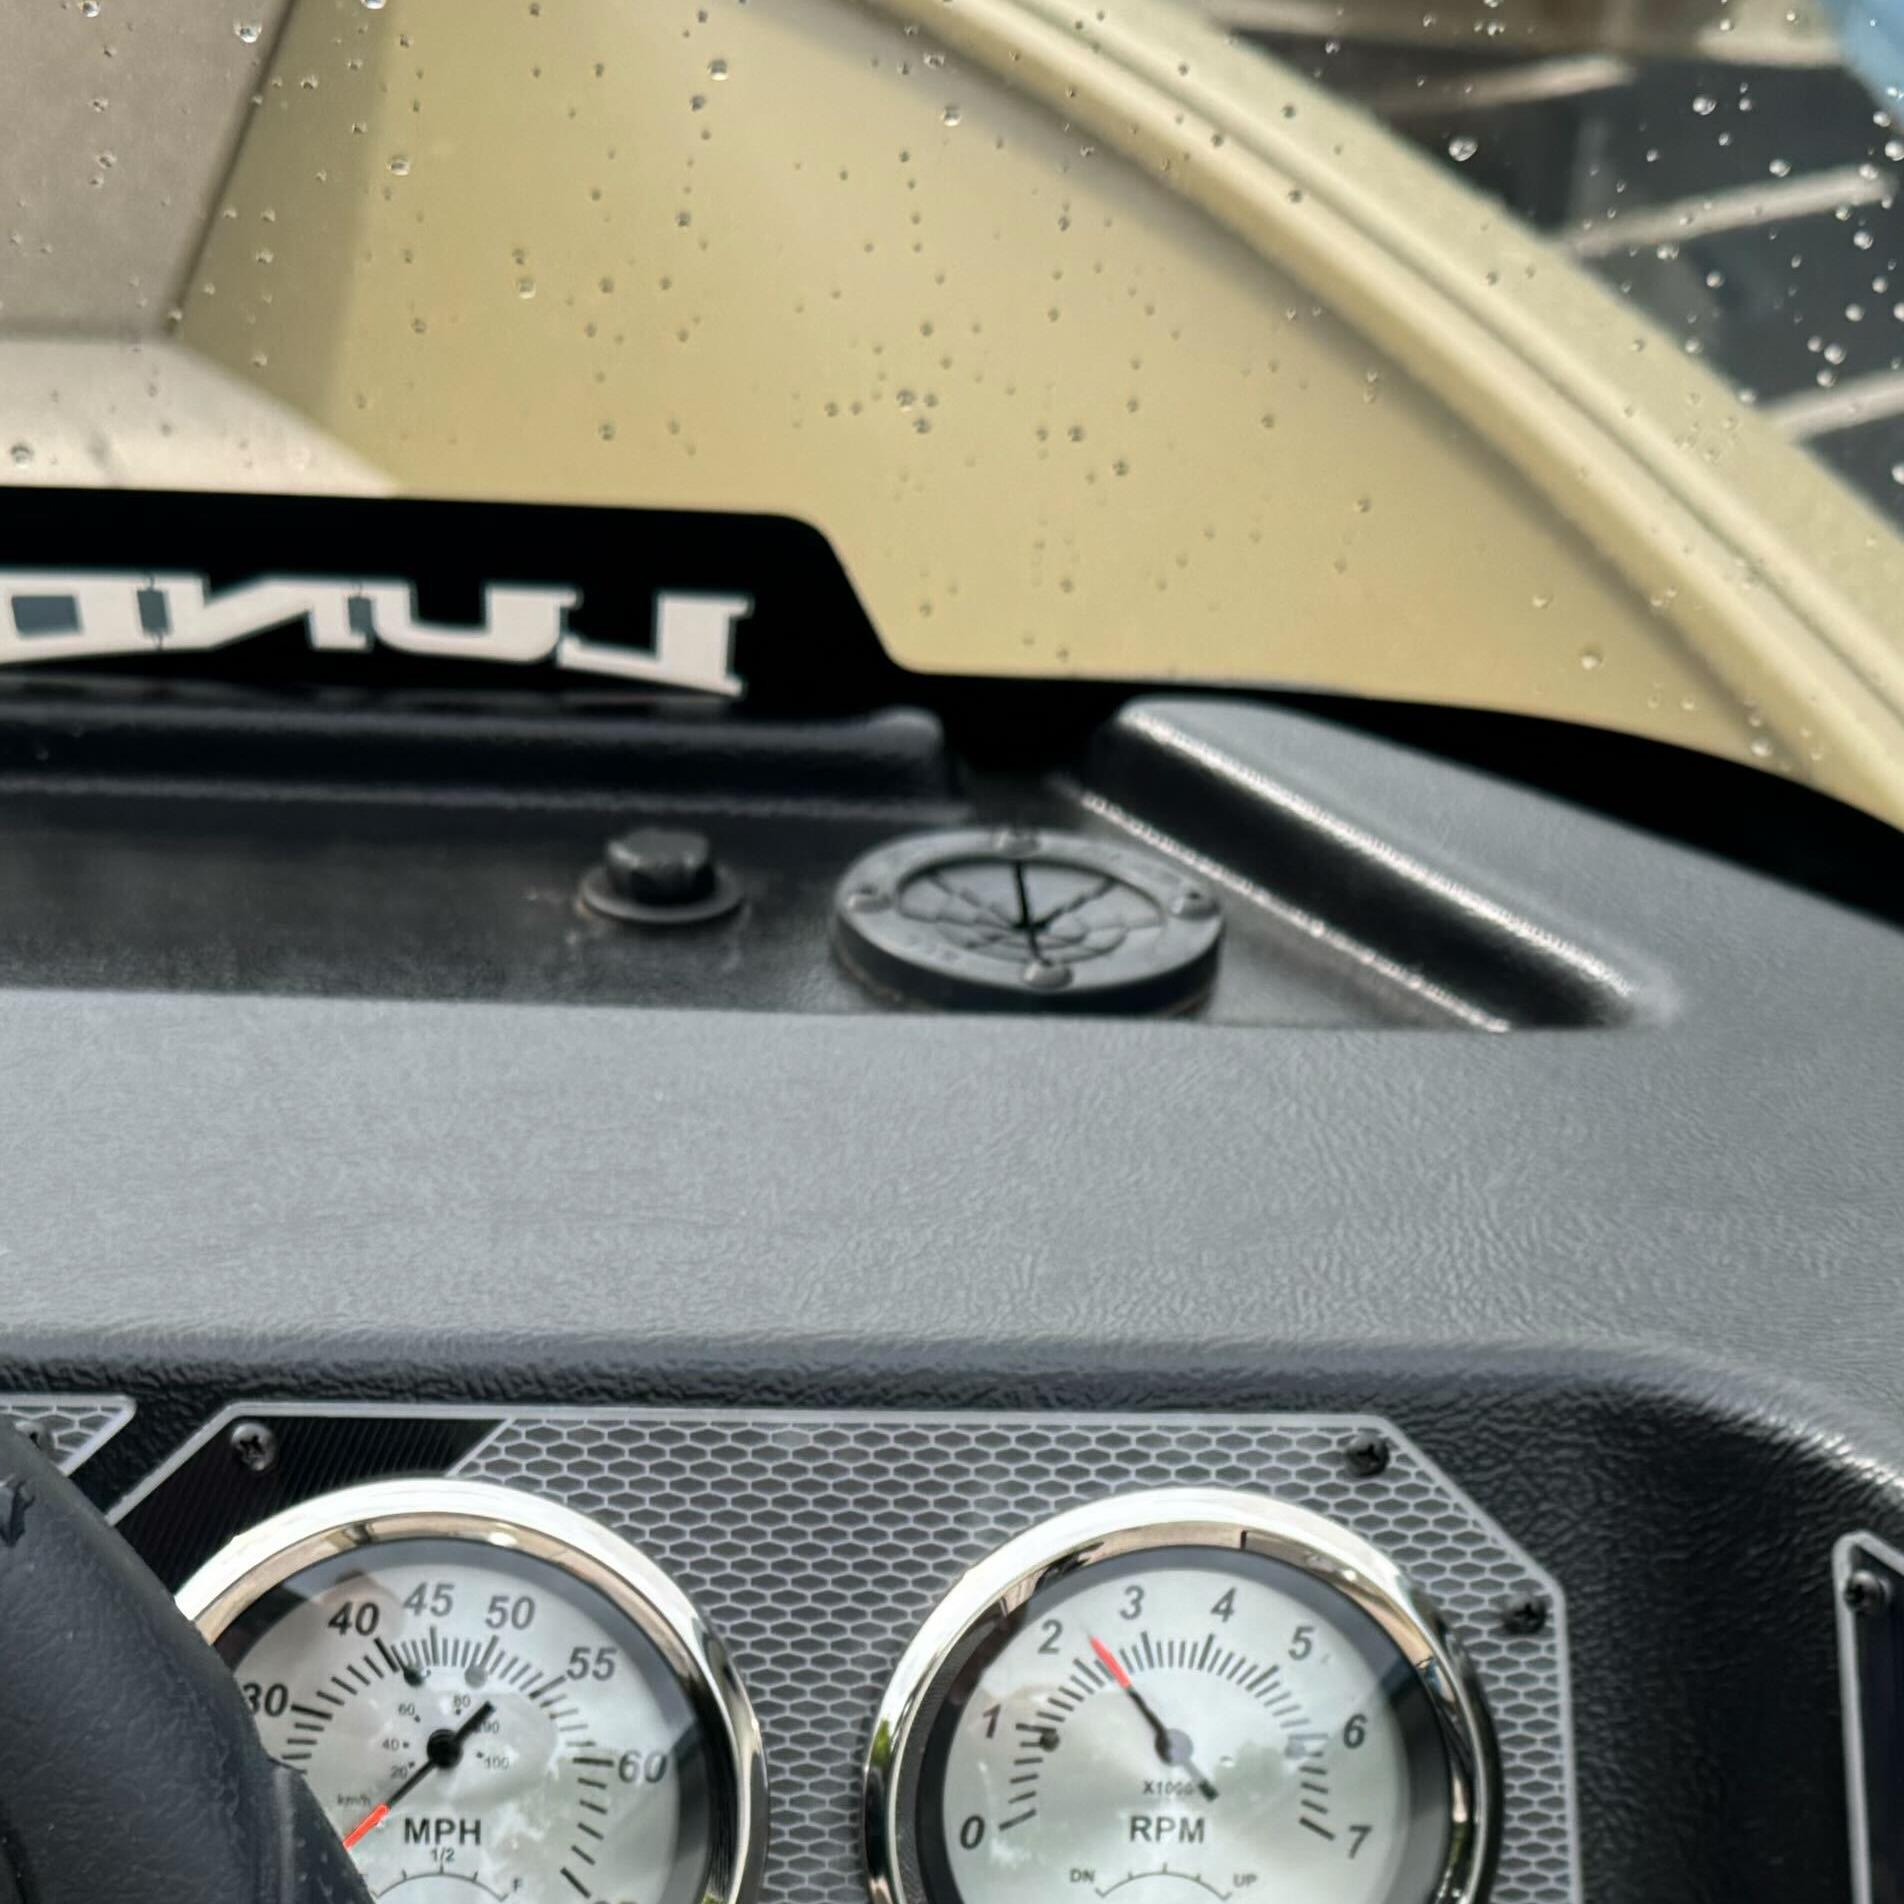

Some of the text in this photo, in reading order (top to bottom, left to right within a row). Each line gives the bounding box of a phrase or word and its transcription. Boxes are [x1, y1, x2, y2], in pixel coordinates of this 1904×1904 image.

[402, 1581, 455, 1618] 45
[485, 1595, 536, 1631] 50
[1120, 1585, 1146, 1620] 3
[1210, 1587, 1237, 1622] 4
[327, 1602, 380, 1637] 40
[1038, 1618, 1065, 1655] 2
[1288, 1625, 1314, 1661] 5
[565, 1646, 617, 1682] 55
[398, 1703, 416, 1718] 60
[982, 1704, 1002, 1739] 1
[382, 1738, 400, 1752] 40
[1342, 1714, 1366, 1749] 6
[390, 1765, 409, 1780] 20
[485, 1754, 510, 1771] 100
[617, 1752, 667, 1785] 60
[404, 1817, 482, 1846] MPH
[959, 1815, 985, 1850] 0
[1129, 1815, 1206, 1844] RPM
[1348, 1825, 1372, 1859] 7
[1069, 1868, 1096, 1884] DN
[1232, 1873, 1257, 1888] UP
